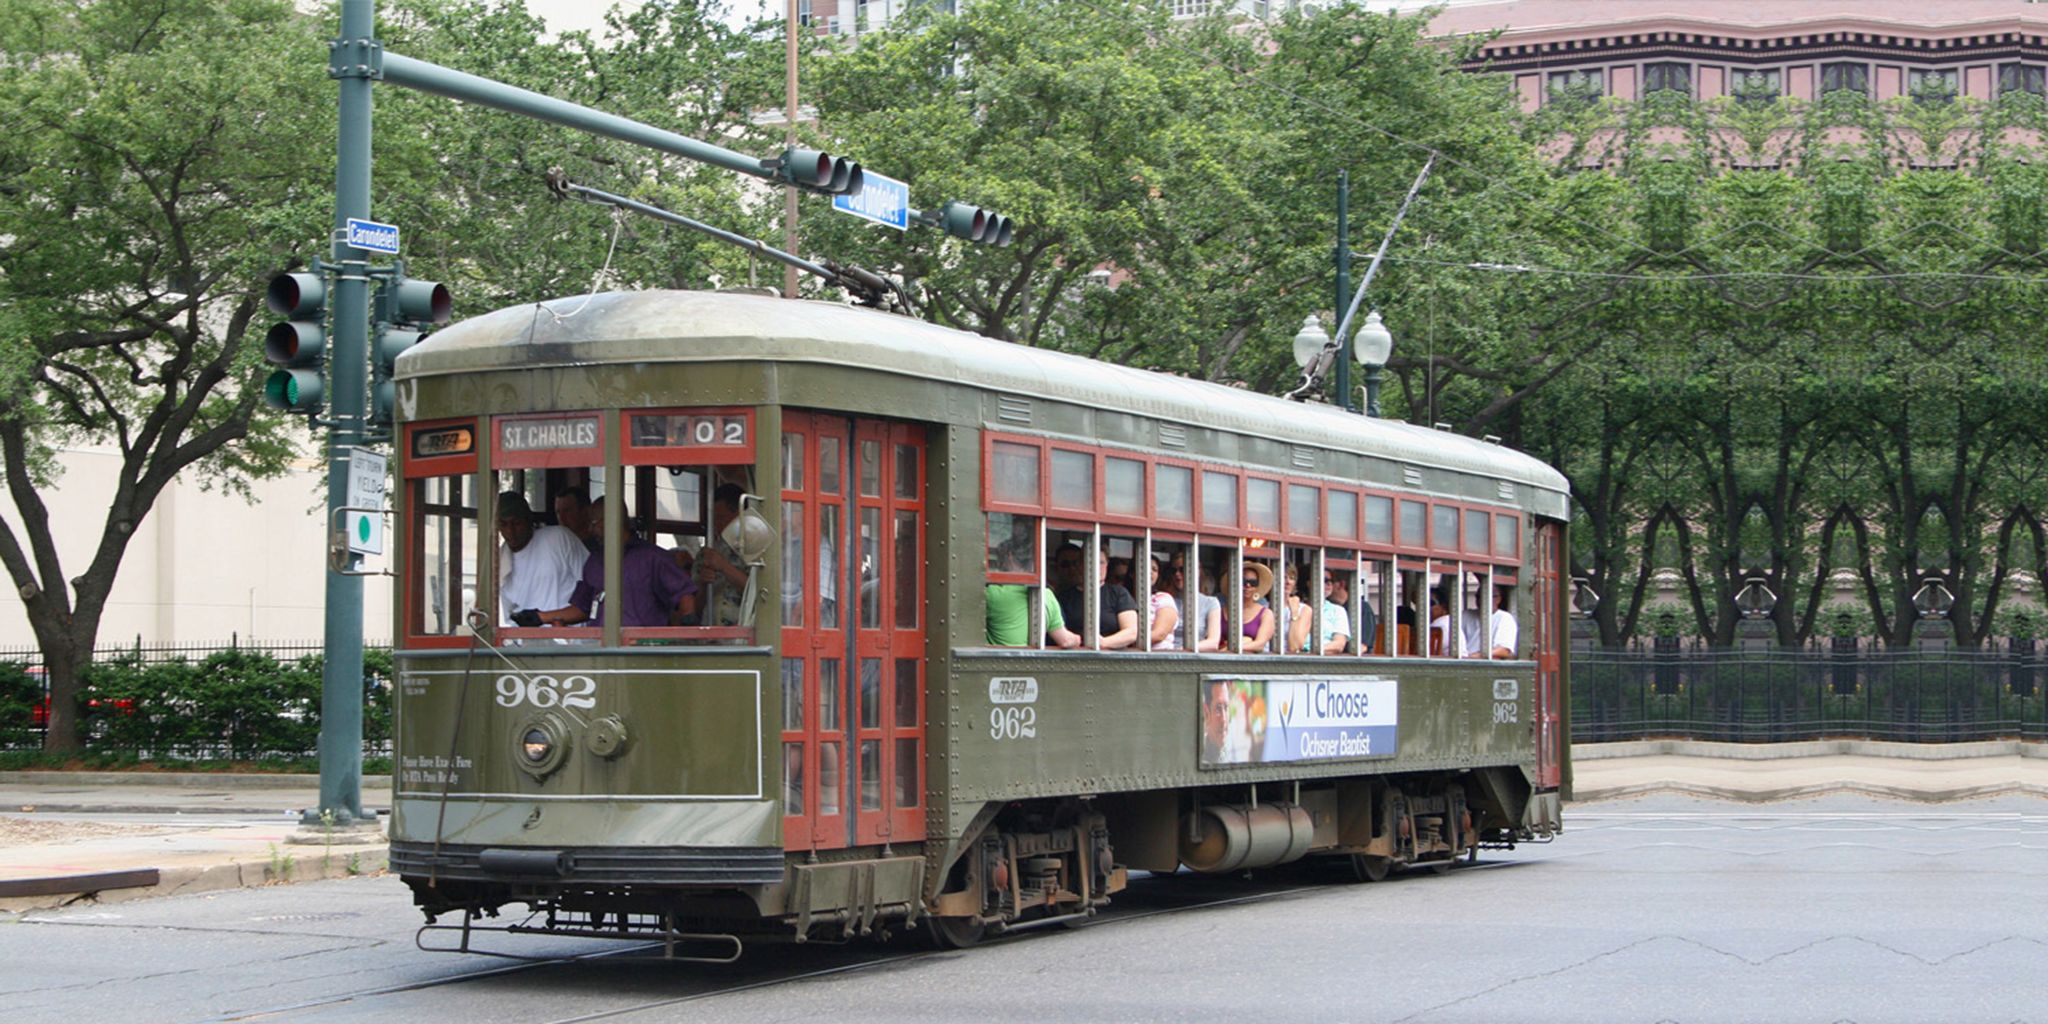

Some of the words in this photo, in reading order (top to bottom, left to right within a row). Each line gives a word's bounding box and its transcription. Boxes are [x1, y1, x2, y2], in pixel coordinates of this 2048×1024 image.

[351, 223, 396, 249] Carondelet
[505, 427, 525, 448] ST.
[528, 423, 595, 447] CHARLES
[496, 675, 596, 708] 962
[1000, 680, 1027, 699] RTA
[1306, 683, 1310, 718] I
[1315, 681, 1368, 718] Choose
[990, 707, 1036, 739] 962
[1493, 702, 1517, 723] 962
[1300, 731, 1339, 757] Ochsner
[1340, 731, 1370, 756] Baptist
[435, 755, 454, 768] Exat
[456, 755, 472, 768] Fare
